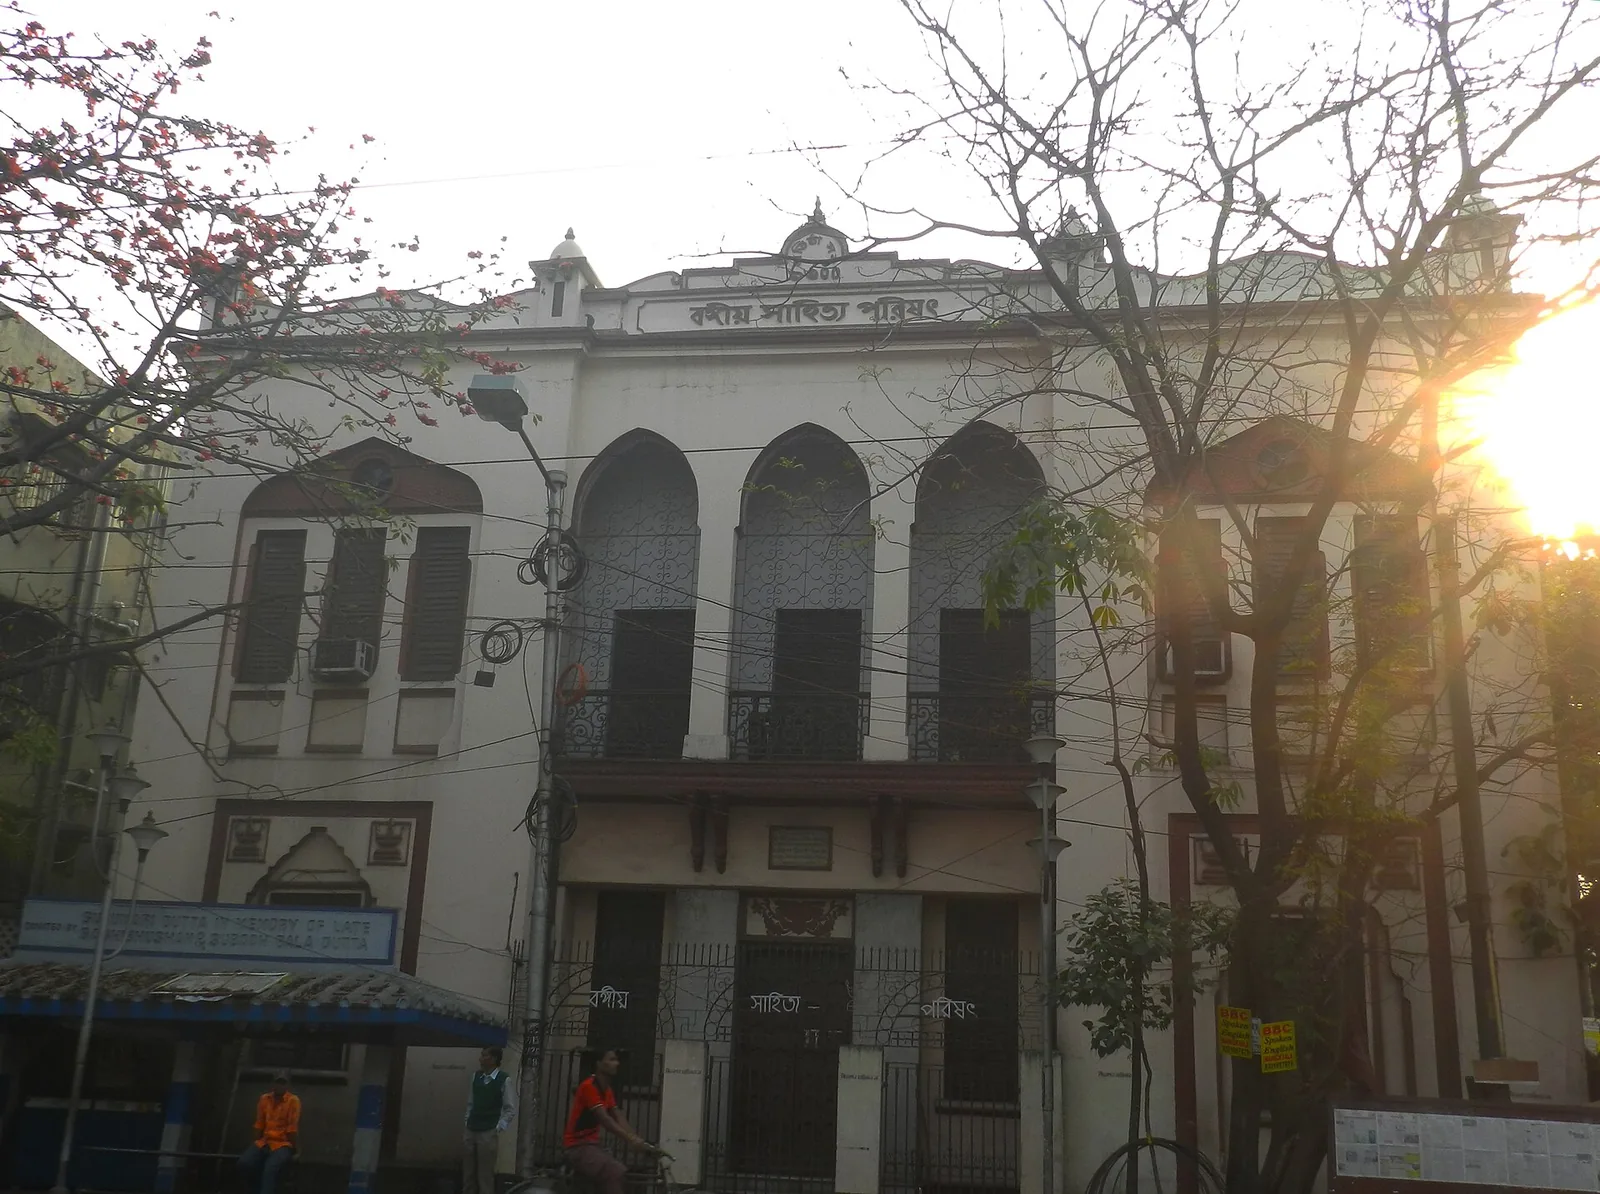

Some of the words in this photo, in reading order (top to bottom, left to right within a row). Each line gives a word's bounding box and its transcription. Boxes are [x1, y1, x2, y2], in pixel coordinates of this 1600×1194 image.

[690, 302, 752, 325] বঙ্গীয়
[760, 298, 850, 323] সাহিত্য
[857, 296, 939, 322] পরিষৎ
[236, 917, 299, 931] MEMORY
[308, 919, 324, 932] OF
[333, 920, 370, 935] LATE
[322, 936, 368, 951] DUTTA
[589, 985, 629, 1009] বঙ্গীয়
[750, 991, 801, 1013] সাহিত্য
[920, 997, 978, 1019] পরিষৎ
[1220, 1008, 1249, 1021] BBC
[1221, 1019, 1249, 1029] Spoken
[1262, 1024, 1291, 1036] BBC
[1221, 1029, 1250, 1039] English
[1264, 1036, 1293, 1045] Spoken
[1264, 1044, 1294, 1054] English
